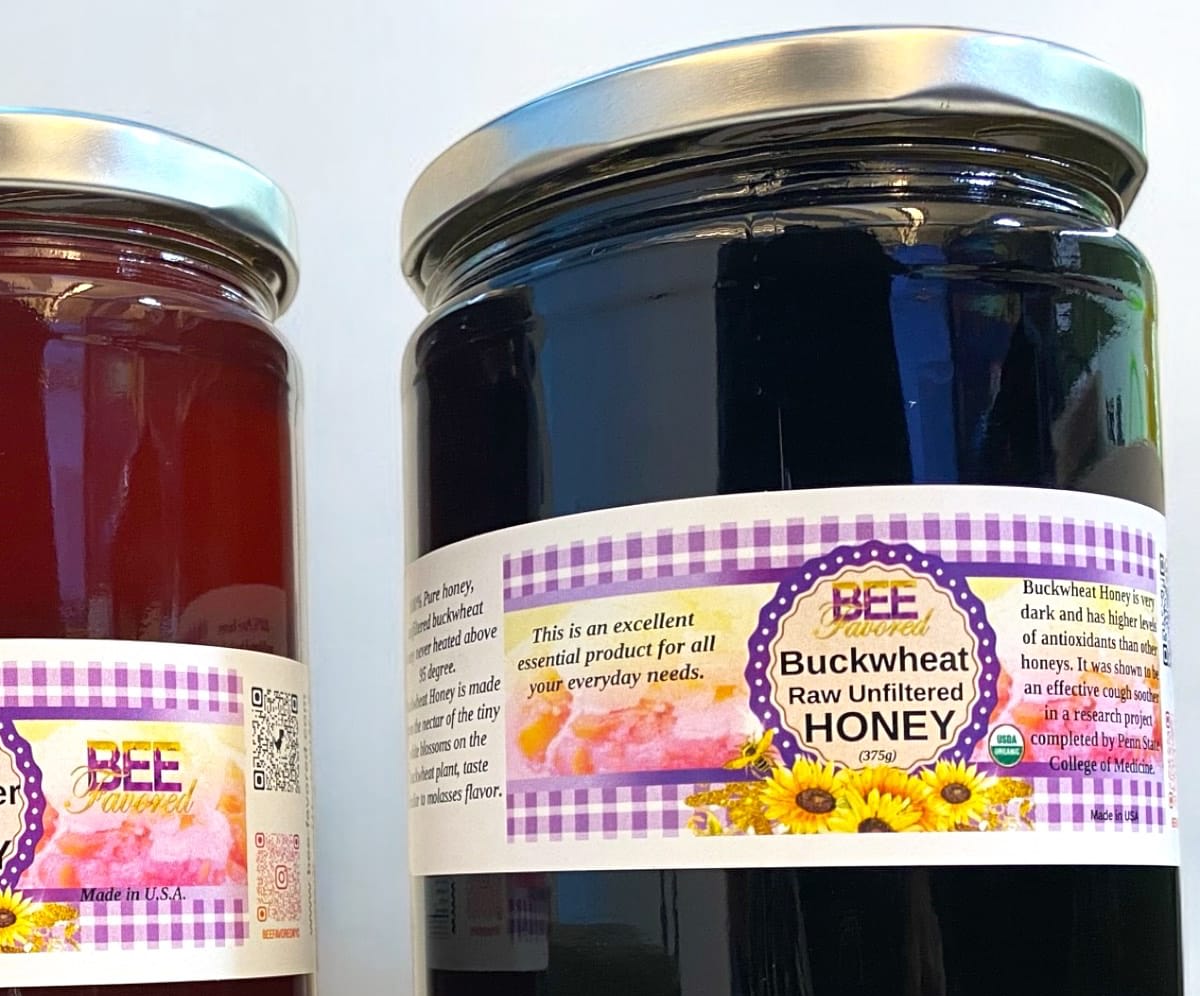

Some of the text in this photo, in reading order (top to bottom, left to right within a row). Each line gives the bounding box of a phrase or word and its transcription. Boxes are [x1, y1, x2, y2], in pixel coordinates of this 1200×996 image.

[442, 580, 474, 597] honey,
[1023, 580, 1131, 606] Buckwheat Honey
[832, 580, 918, 621] BEE
[432, 601, 483, 627] buckwheat
[814, 603, 934, 640] Favored
[1021, 604, 1137, 630] dark and has higher
[532, 612, 694, 643] This an excellent
[433, 626, 497, 653] heated above
[1023, 629, 1138, 652] of antioxidants than
[518, 635, 716, 671] essential product for all
[781, 647, 969, 676] Buckwheat
[428, 662, 455, 682] degree.
[1021, 654, 1142, 676] honeys. was shown
[429, 687, 455, 704] Honey
[469, 675, 501, 695] made
[528, 664, 704, 699] your everyday needs.
[1025, 680, 1131, 703] an effective cough
[789, 683, 963, 704] Raw Unfiltered
[458, 704, 500, 723] the tiny
[1075, 708, 1152, 729] research project
[806, 709, 956, 742] HONEY
[470, 731, 487, 747] the
[1031, 733, 1140, 749] completed Penn
[87, 740, 182, 792] BEE
[859, 749, 896, 763] (375g)
[1050, 756, 1155, 775] College Medicine.
[436, 762, 460, 782] plant,
[463, 760, 488, 774] taste
[64, 765, 198, 814] Favored
[465, 784, 502, 804] flavor.
[1091, 809, 1138, 821] Made in USA
[80, 887, 186, 902] Made in U.S.A.
